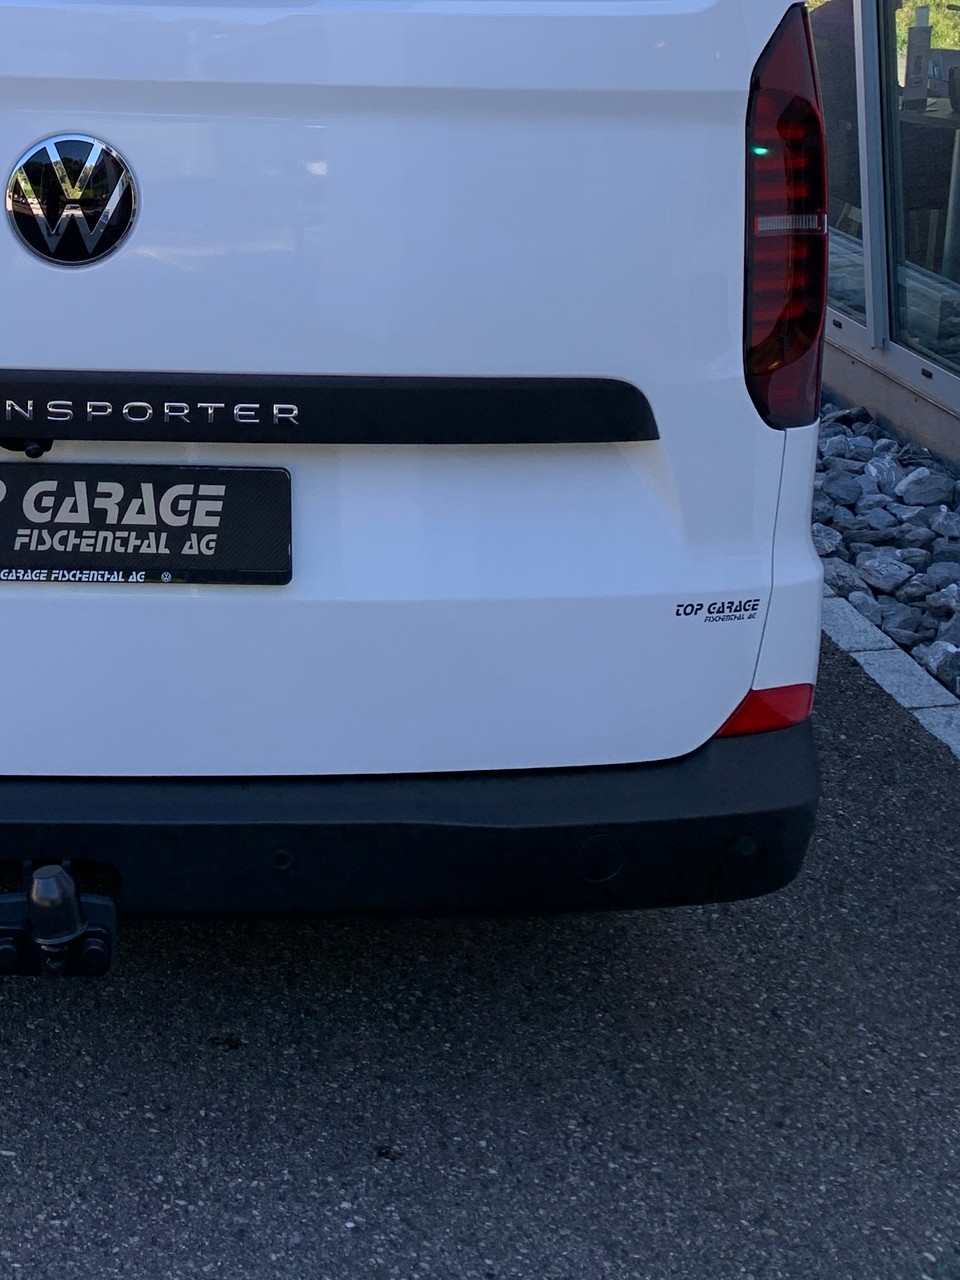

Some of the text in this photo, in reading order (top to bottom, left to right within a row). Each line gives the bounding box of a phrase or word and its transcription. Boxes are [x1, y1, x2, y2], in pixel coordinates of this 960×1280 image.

[6, 133, 138, 267] VW
[22, 480, 226, 527] GARAGE
[13, 528, 218, 556] FISCHENTHAL AG
[0, 569, 48, 581] GARAGE
[50, 570, 125, 582] FISCHENTHAL
[128, 572, 146, 582] AG
[675, 599, 760, 616] TOP GARAGE
